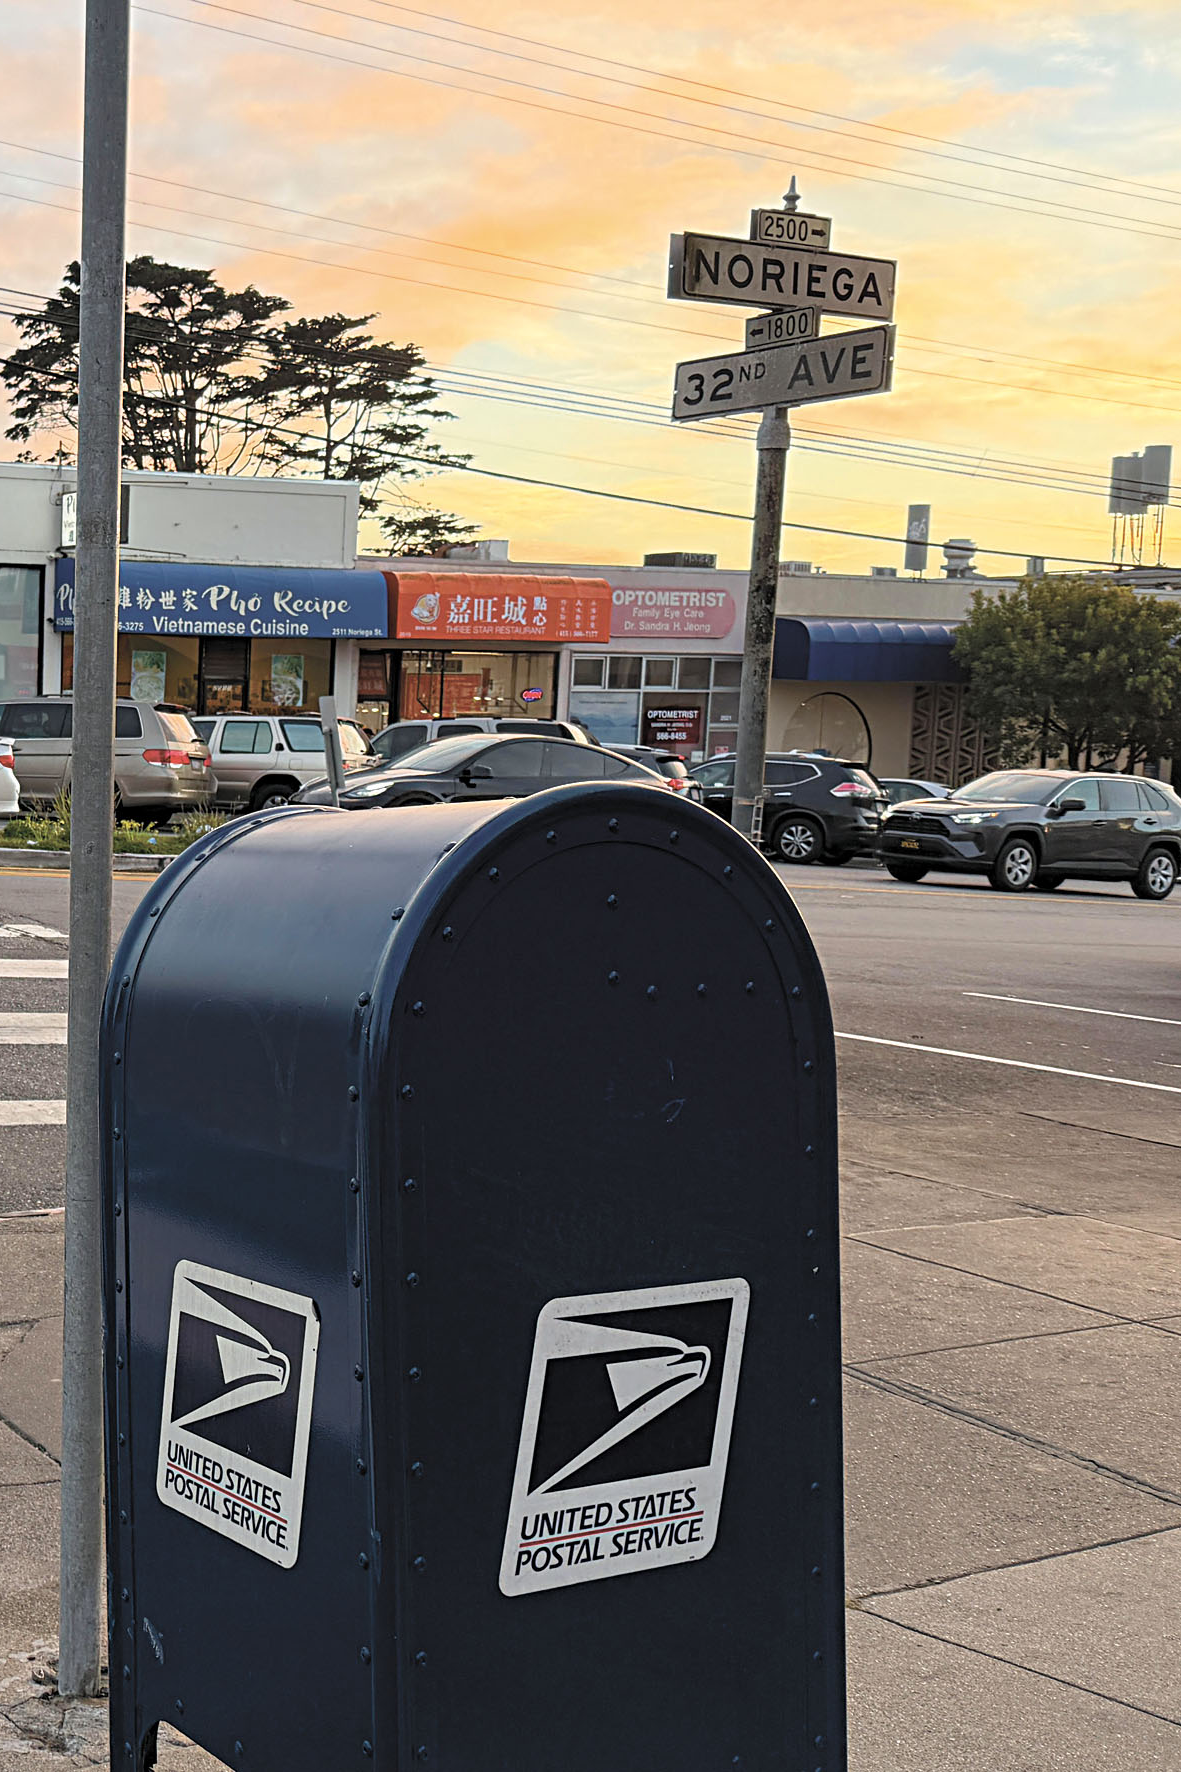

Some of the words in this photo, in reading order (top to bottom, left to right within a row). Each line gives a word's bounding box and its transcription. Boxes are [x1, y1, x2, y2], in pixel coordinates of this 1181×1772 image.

[764, 215, 808, 242] 2500
[694, 249, 883, 307] NORIEGA
[768, 312, 808, 341] 1800
[683, 362, 766, 406] 32ND
[787, 343, 874, 390] AVE
[273, 590, 352, 620] Recipe
[446, 594, 528, 626] 嘉旺城
[612, 590, 726, 607] OPTOMETRIST
[632, 607, 660, 619] Family
[664, 607, 680, 619] Eye
[683, 608, 704, 618] Care
[152, 615, 246, 635] Vietnamese
[250, 618, 309, 635] Cuisine
[332, 628, 347, 636] 2511
[348, 628, 373, 637] Noriega
[446, 625, 471, 634] THREE
[472, 625, 494, 634] STAR
[495, 626, 547, 635] RESTAURANT
[624, 621, 636, 630] Dr.
[639, 621, 669, 631] Sandra
[683, 622, 711, 633] Jeong
[647, 710, 699, 719] OPTOMETRIST
[167, 1440, 223, 1484] UNITED
[225, 1468, 282, 1513] STATES
[165, 1468, 219, 1515] POSTAL
[521, 1502, 613, 1540] UNITED
[616, 1486, 696, 1523] STATES
[515, 1537, 604, 1576] POSTAL
